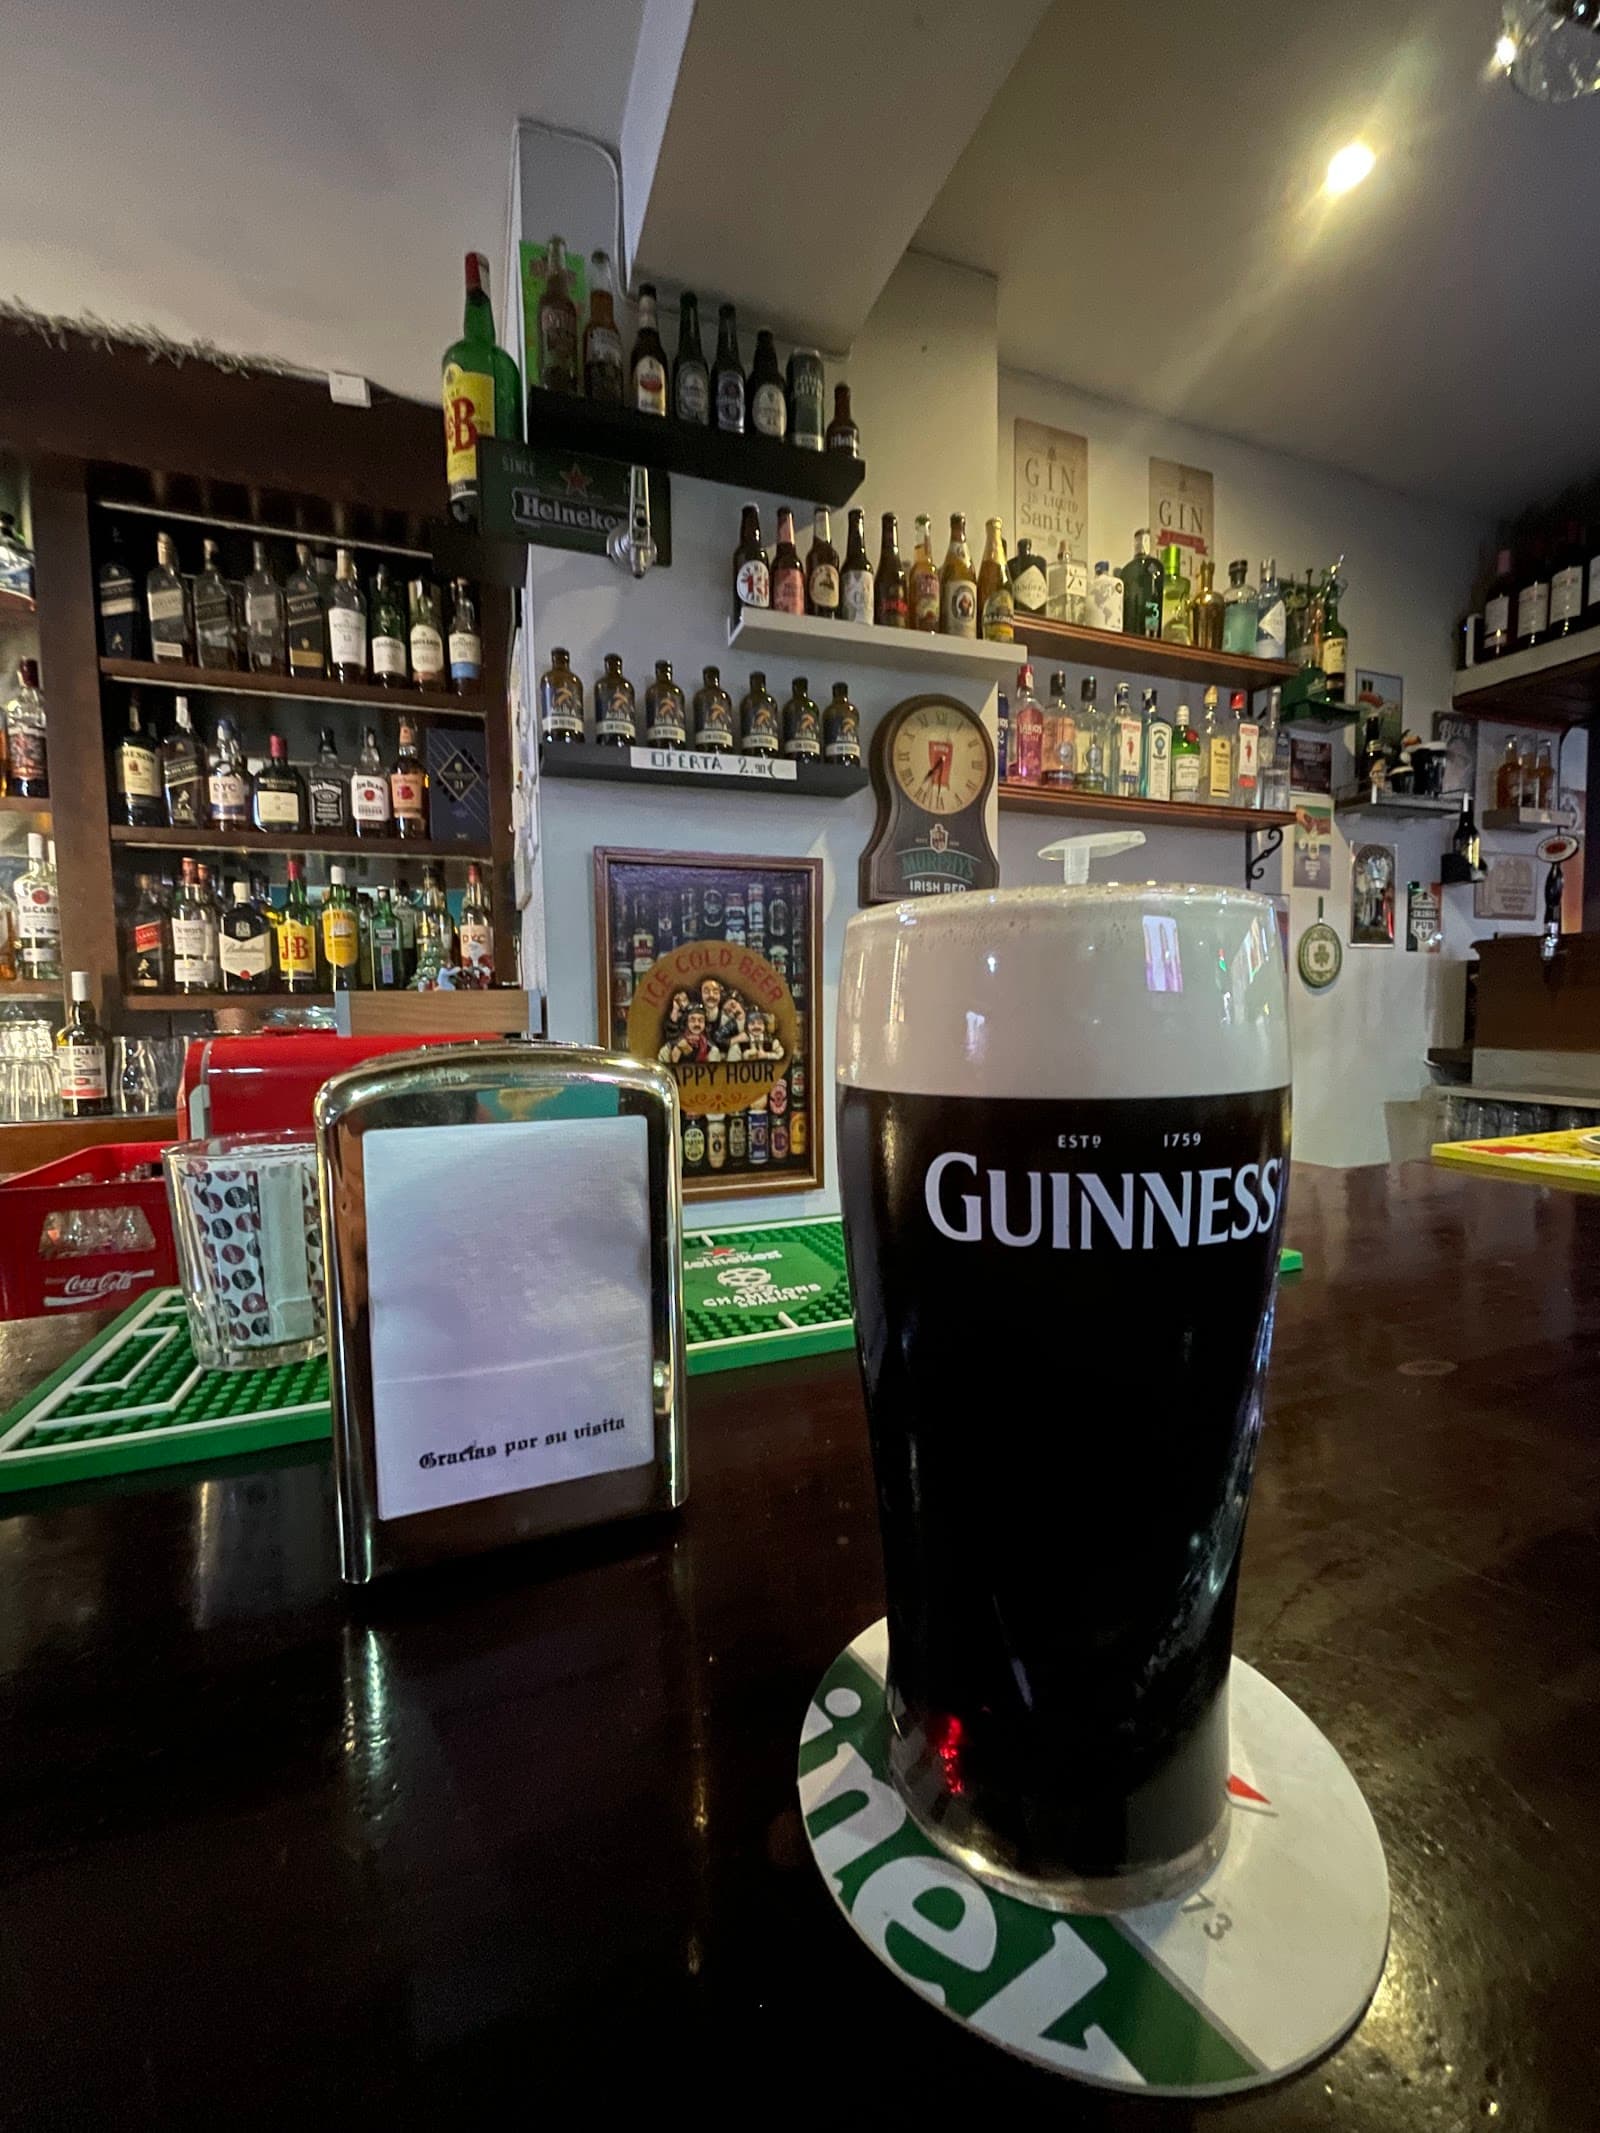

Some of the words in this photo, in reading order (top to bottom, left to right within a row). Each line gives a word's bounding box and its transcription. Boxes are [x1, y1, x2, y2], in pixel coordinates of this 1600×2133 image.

[1025, 456, 1075, 496] GIN
[1020, 503, 1084, 540] Sanity
[1159, 499, 1204, 533] GIN
[651, 751, 723, 771] OFERTA
[213, 781, 237, 793] DYC
[909, 879, 941, 893] IRISH
[943, 882, 966, 894] RED
[22, 905, 58, 914] BACARD
[1415, 920, 1434, 930] PUB
[641, 969, 674, 1008] ICE
[674, 949, 732, 975] COLD
[738, 954, 785, 1004] BEER
[673, 1065, 718, 1087] APPY
[726, 1063, 774, 1085] HOUR
[1057, 1134, 1102, 1149] ESTD
[1163, 1132, 1202, 1148] 1759
[924, 1151, 1283, 1251] GUINNESS
[419, 1440, 498, 1470] Gracias
[505, 1436, 538, 1457] por
[545, 1429, 568, 1446] su
[574, 1417, 626, 1440] visita
